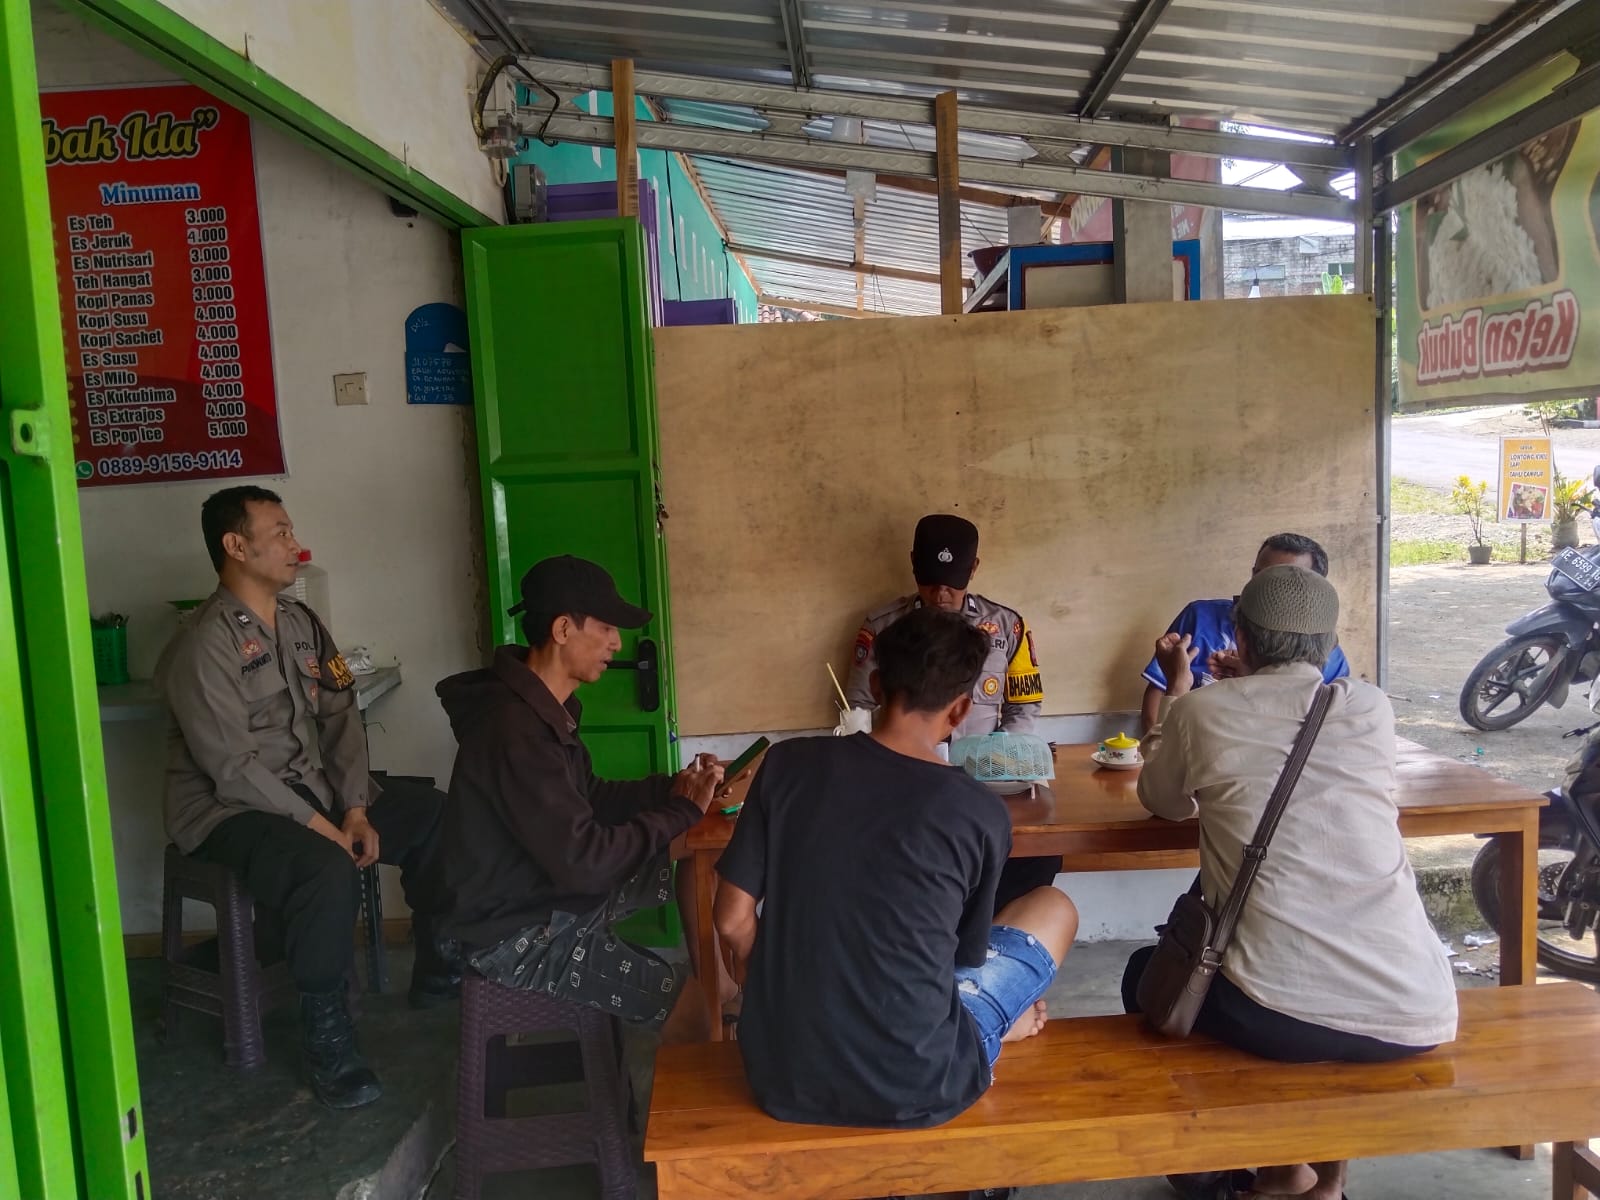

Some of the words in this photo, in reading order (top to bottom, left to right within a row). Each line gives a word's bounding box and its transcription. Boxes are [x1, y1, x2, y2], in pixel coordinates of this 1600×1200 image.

[102, 184, 199, 204] Minuman
[68, 216, 86, 231] Es
[87, 215, 113, 230] Teh
[186, 207, 225, 224] 3.000
[70, 236, 88, 251] Es
[91, 233, 132, 250] Jeruk
[72, 256, 90, 270] Es
[92, 251, 153, 269] Nutrisari
[190, 246, 228, 263] 3.000
[74, 275, 99, 290] Teh
[101, 272, 152, 288] Hangat
[192, 265, 230, 282] 3.000
[76, 294, 108, 310] Kopi
[111, 293, 153, 308] Panas
[194, 285, 233, 302] 3.000
[78, 313, 110, 329] Kopi
[112, 312, 147, 327] Susu
[195, 305, 235, 321] 4.000
[80, 333, 112, 349] Kopi
[115, 330, 162, 346] Sachet
[197, 325, 237, 340] 4.000
[82, 353, 99, 367] Es
[102, 352, 137, 366] Susu
[199, 344, 239, 360] 4.000
[84, 372, 101, 387] Es
[103, 370, 136, 385] Milo
[201, 363, 241, 379] 4.000
[87, 392, 104, 406] Es
[203, 383, 243, 399] 4.000
[89, 411, 107, 426] Es
[108, 408, 164, 425] Extrajos
[206, 402, 244, 418] 4.000
[91, 430, 109, 445] Es
[111, 429, 138, 445] Pop
[140, 427, 163, 442] Ice
[209, 421, 246, 437] 5.000
[99, 450, 241, 476] 0889-9156-9114
[1560, 549, 1574, 560] AE
[1571, 557, 1593, 573] 6599
